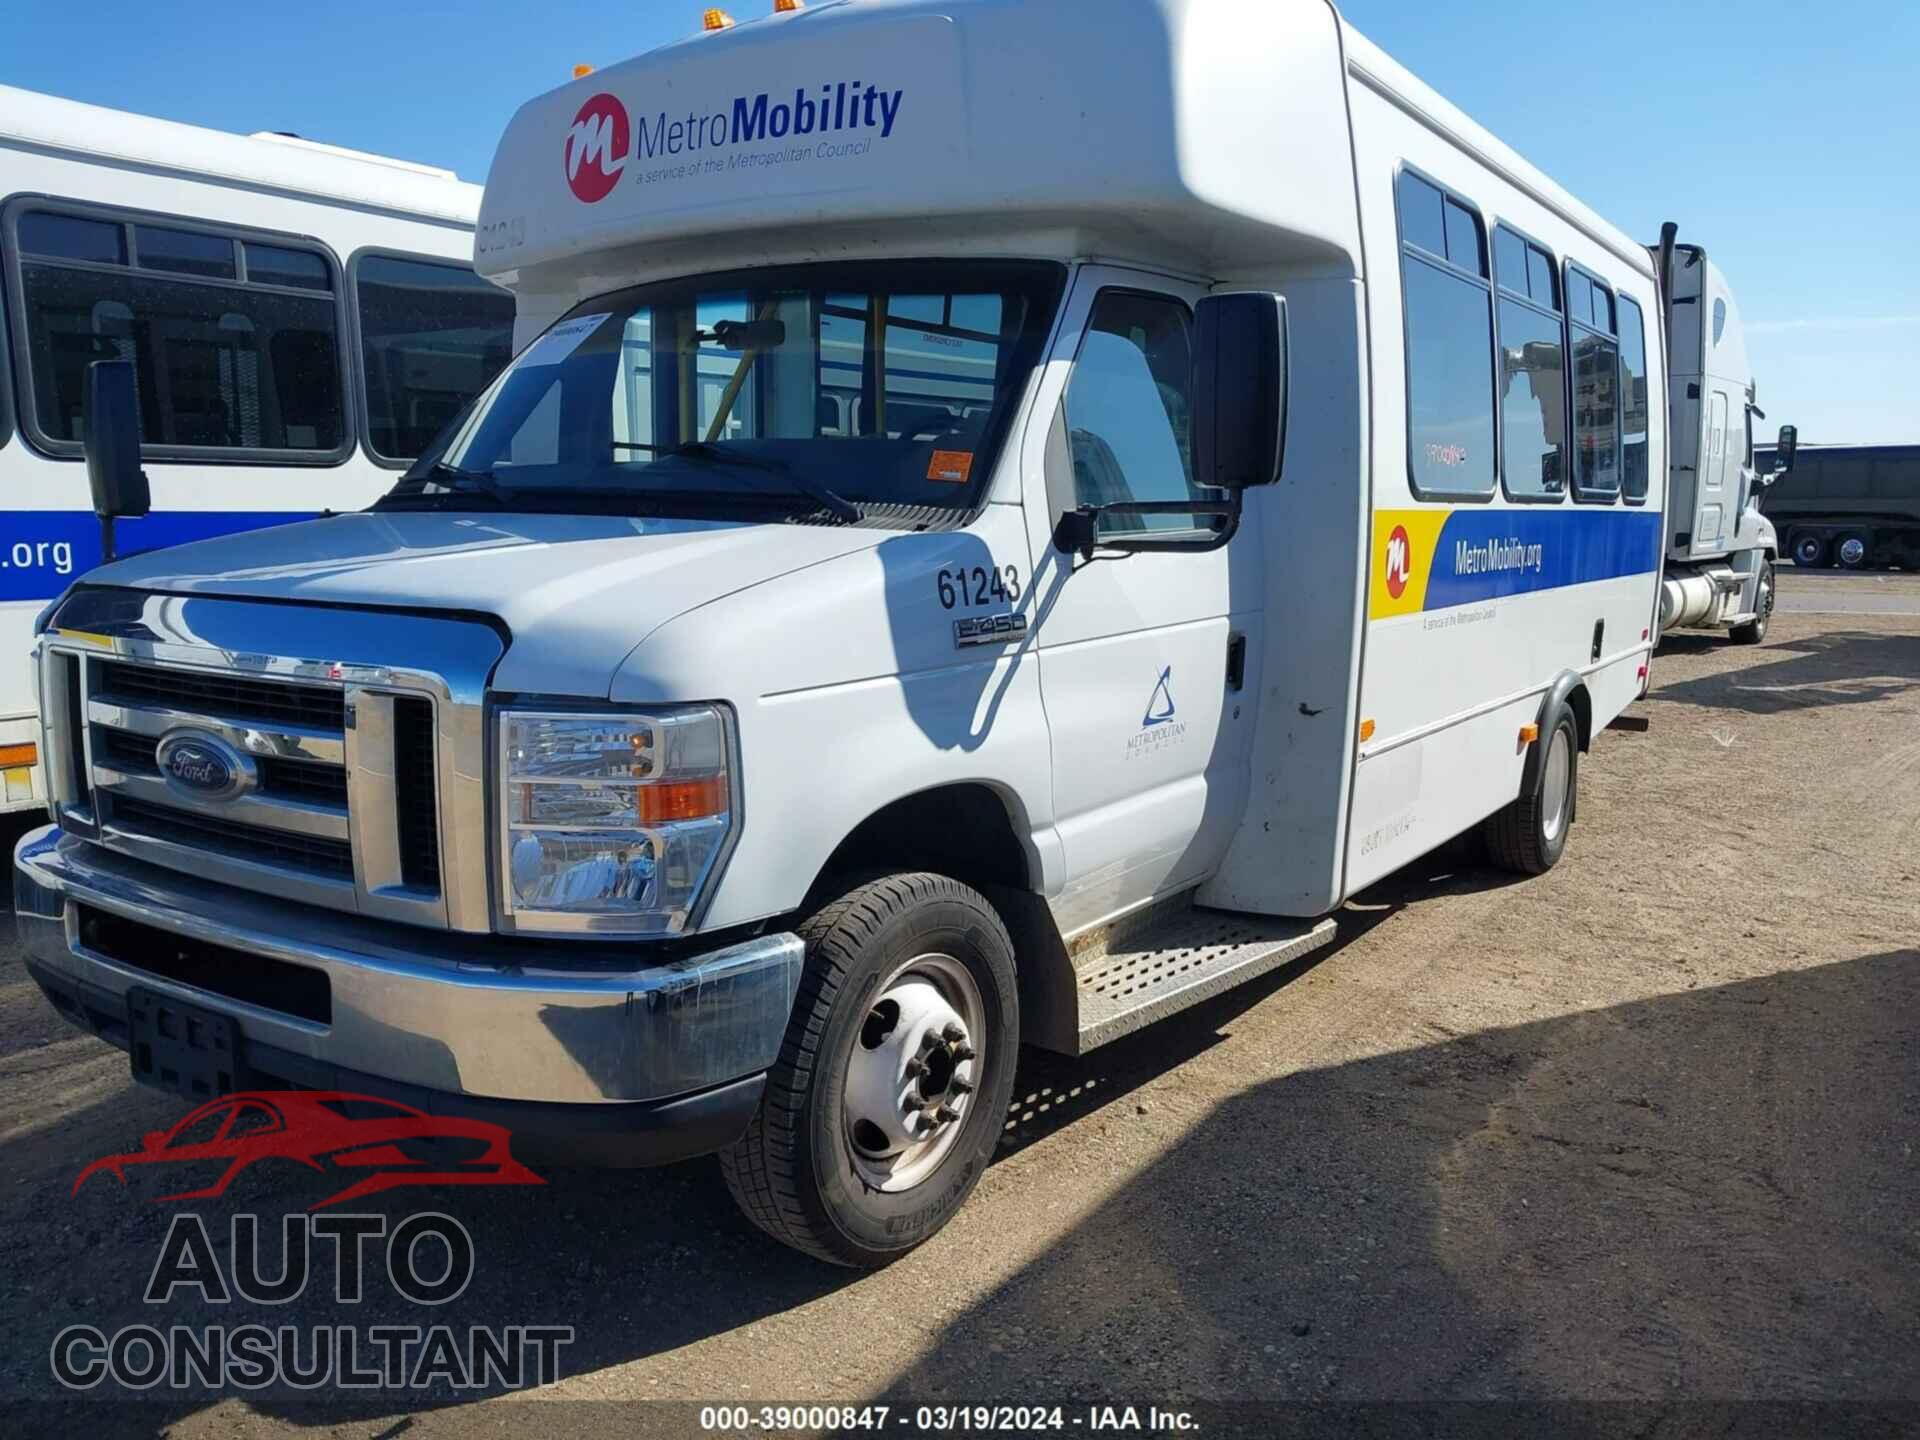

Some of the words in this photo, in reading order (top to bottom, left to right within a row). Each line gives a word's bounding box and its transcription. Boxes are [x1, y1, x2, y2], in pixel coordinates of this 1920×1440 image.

[636, 80, 904, 161] MetroMobility
[645, 167, 685, 183] service
[688, 162, 702, 177] of
[704, 158, 724, 174] the
[727, 146, 813, 171] Metropolitan
[816, 138, 872, 160] Council
[1455, 537, 1542, 576] MetroMobility.org
[937, 564, 1021, 611] 61243
[172, 750, 214, 783] Ford
